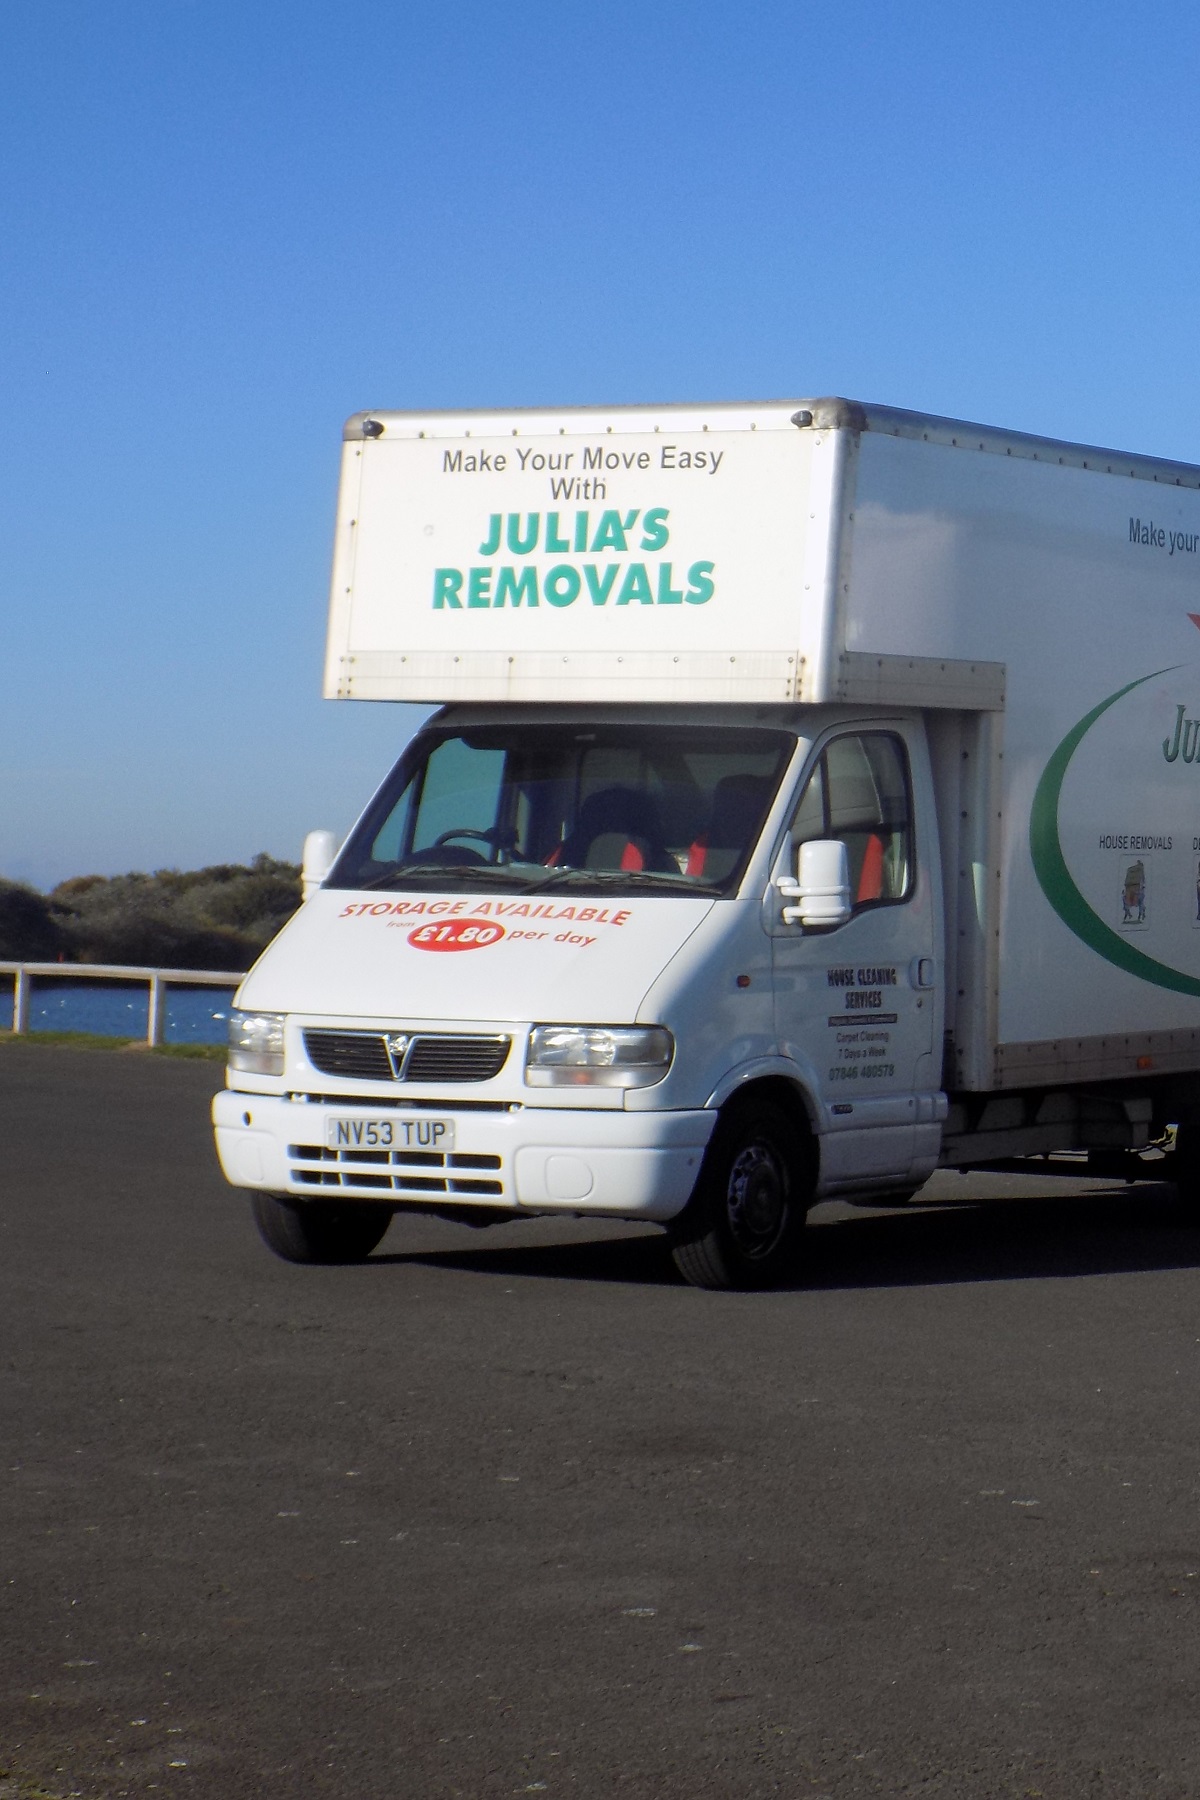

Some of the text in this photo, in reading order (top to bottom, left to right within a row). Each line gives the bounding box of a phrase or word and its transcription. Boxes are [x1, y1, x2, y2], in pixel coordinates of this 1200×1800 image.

[442, 445, 724, 475] Make Your Move Easy
[550, 477, 607, 500] With
[478, 507, 670, 556] JULIA'S
[1128, 517, 1166, 548] Make
[1169, 531, 1200, 556] your
[432, 560, 716, 609] REMOVALS
[1099, 836, 1173, 851] HOUSE REMOVALS
[338, 901, 632, 927] STORAGE AVAILABLE
[386, 920, 598, 948] from £1.80 per day
[857, 968, 897, 986] CLEANING
[845, 991, 882, 1009] SERVICES
[337, 1121, 445, 1146] NV53 TUP
